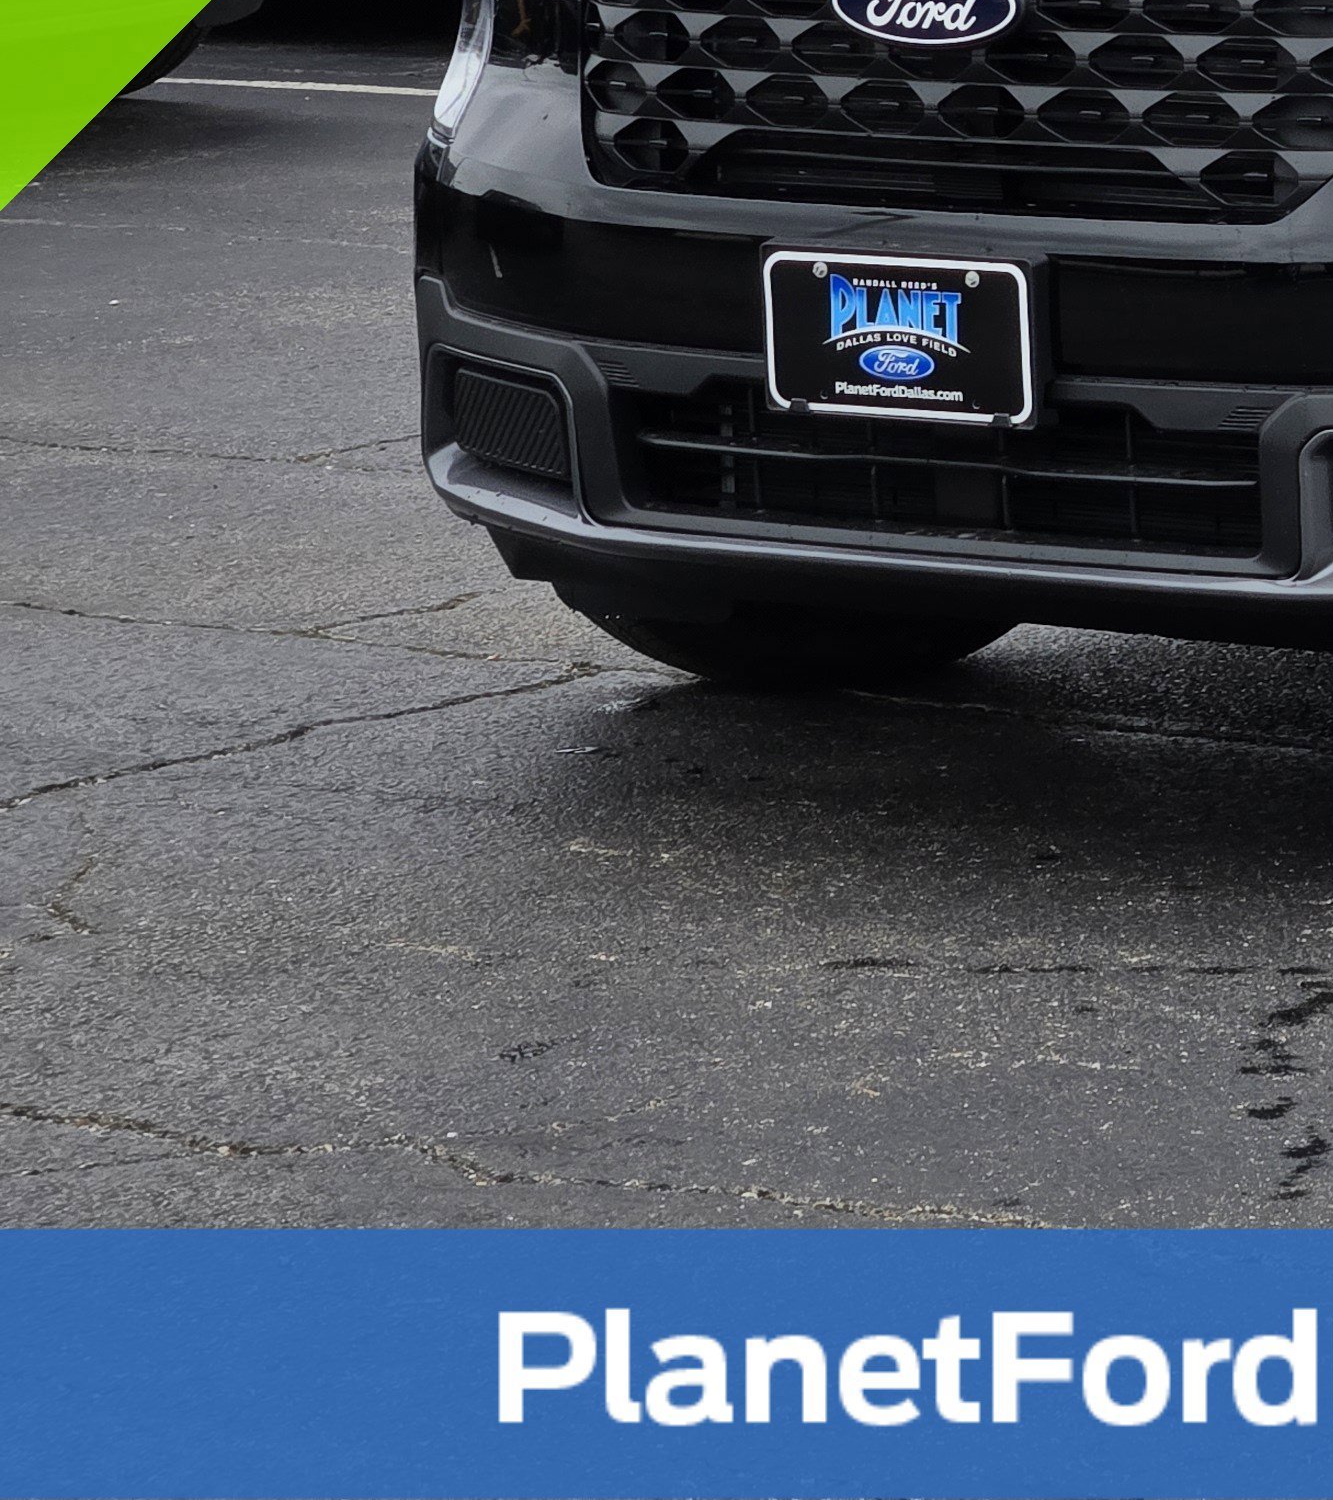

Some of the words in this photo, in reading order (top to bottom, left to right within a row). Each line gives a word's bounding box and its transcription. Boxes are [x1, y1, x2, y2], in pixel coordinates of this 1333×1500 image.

[829, 273, 963, 345] PLANET
[836, 332, 882, 351] DALLAS
[886, 332, 918, 345] LOVE
[921, 337, 957, 358] FIELD
[873, 350, 920, 376] Ford
[835, 381, 964, 402] PlanetFordDallas.com
